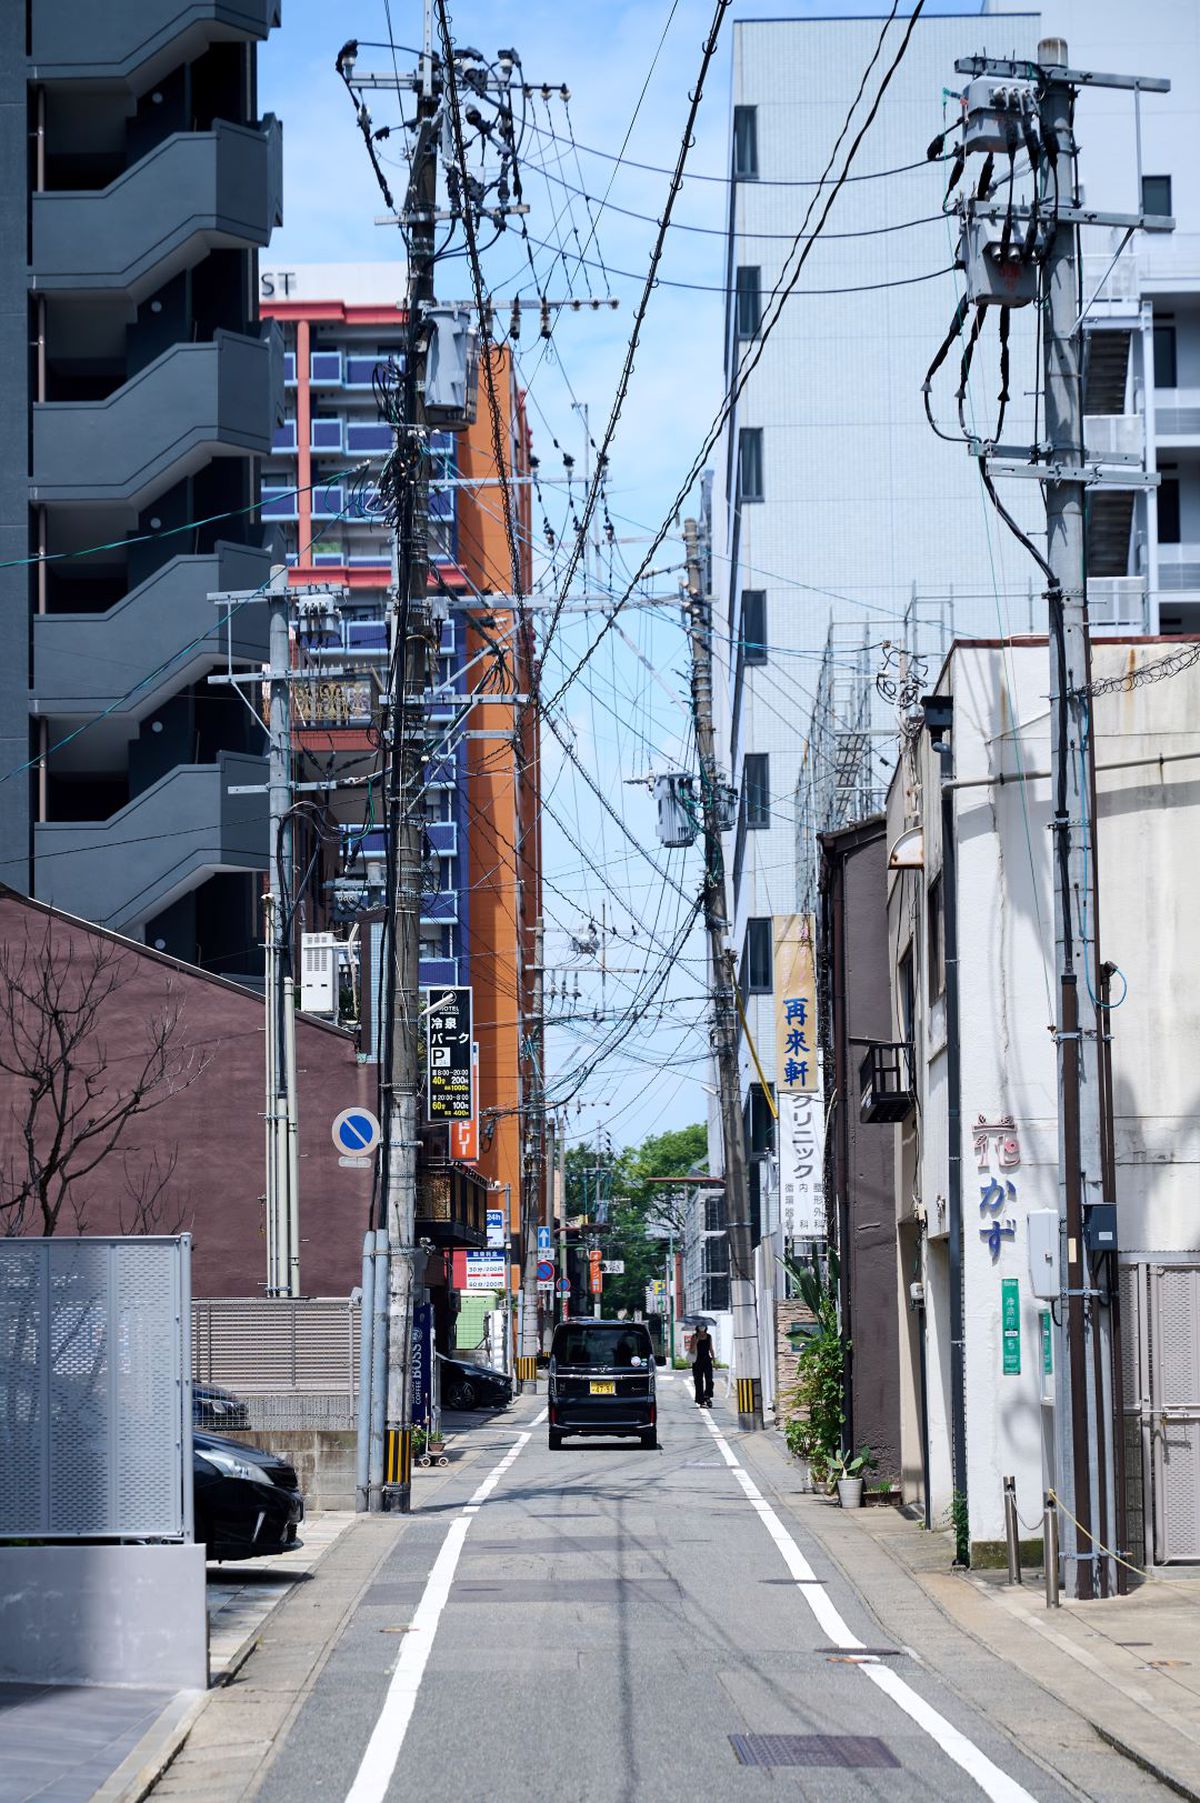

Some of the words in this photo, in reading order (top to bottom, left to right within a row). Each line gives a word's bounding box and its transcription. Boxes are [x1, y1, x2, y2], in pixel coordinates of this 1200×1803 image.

[261, 273, 295, 296] ST
[431, 1017, 457, 1030] 冷泉
[431, 1032, 469, 1044] パーク
[783, 997, 810, 1087] 再來軒
[792, 1094, 815, 1180] クリニック
[652, 1281, 666, 1296] P
[411, 1343, 422, 1379] BOSS
